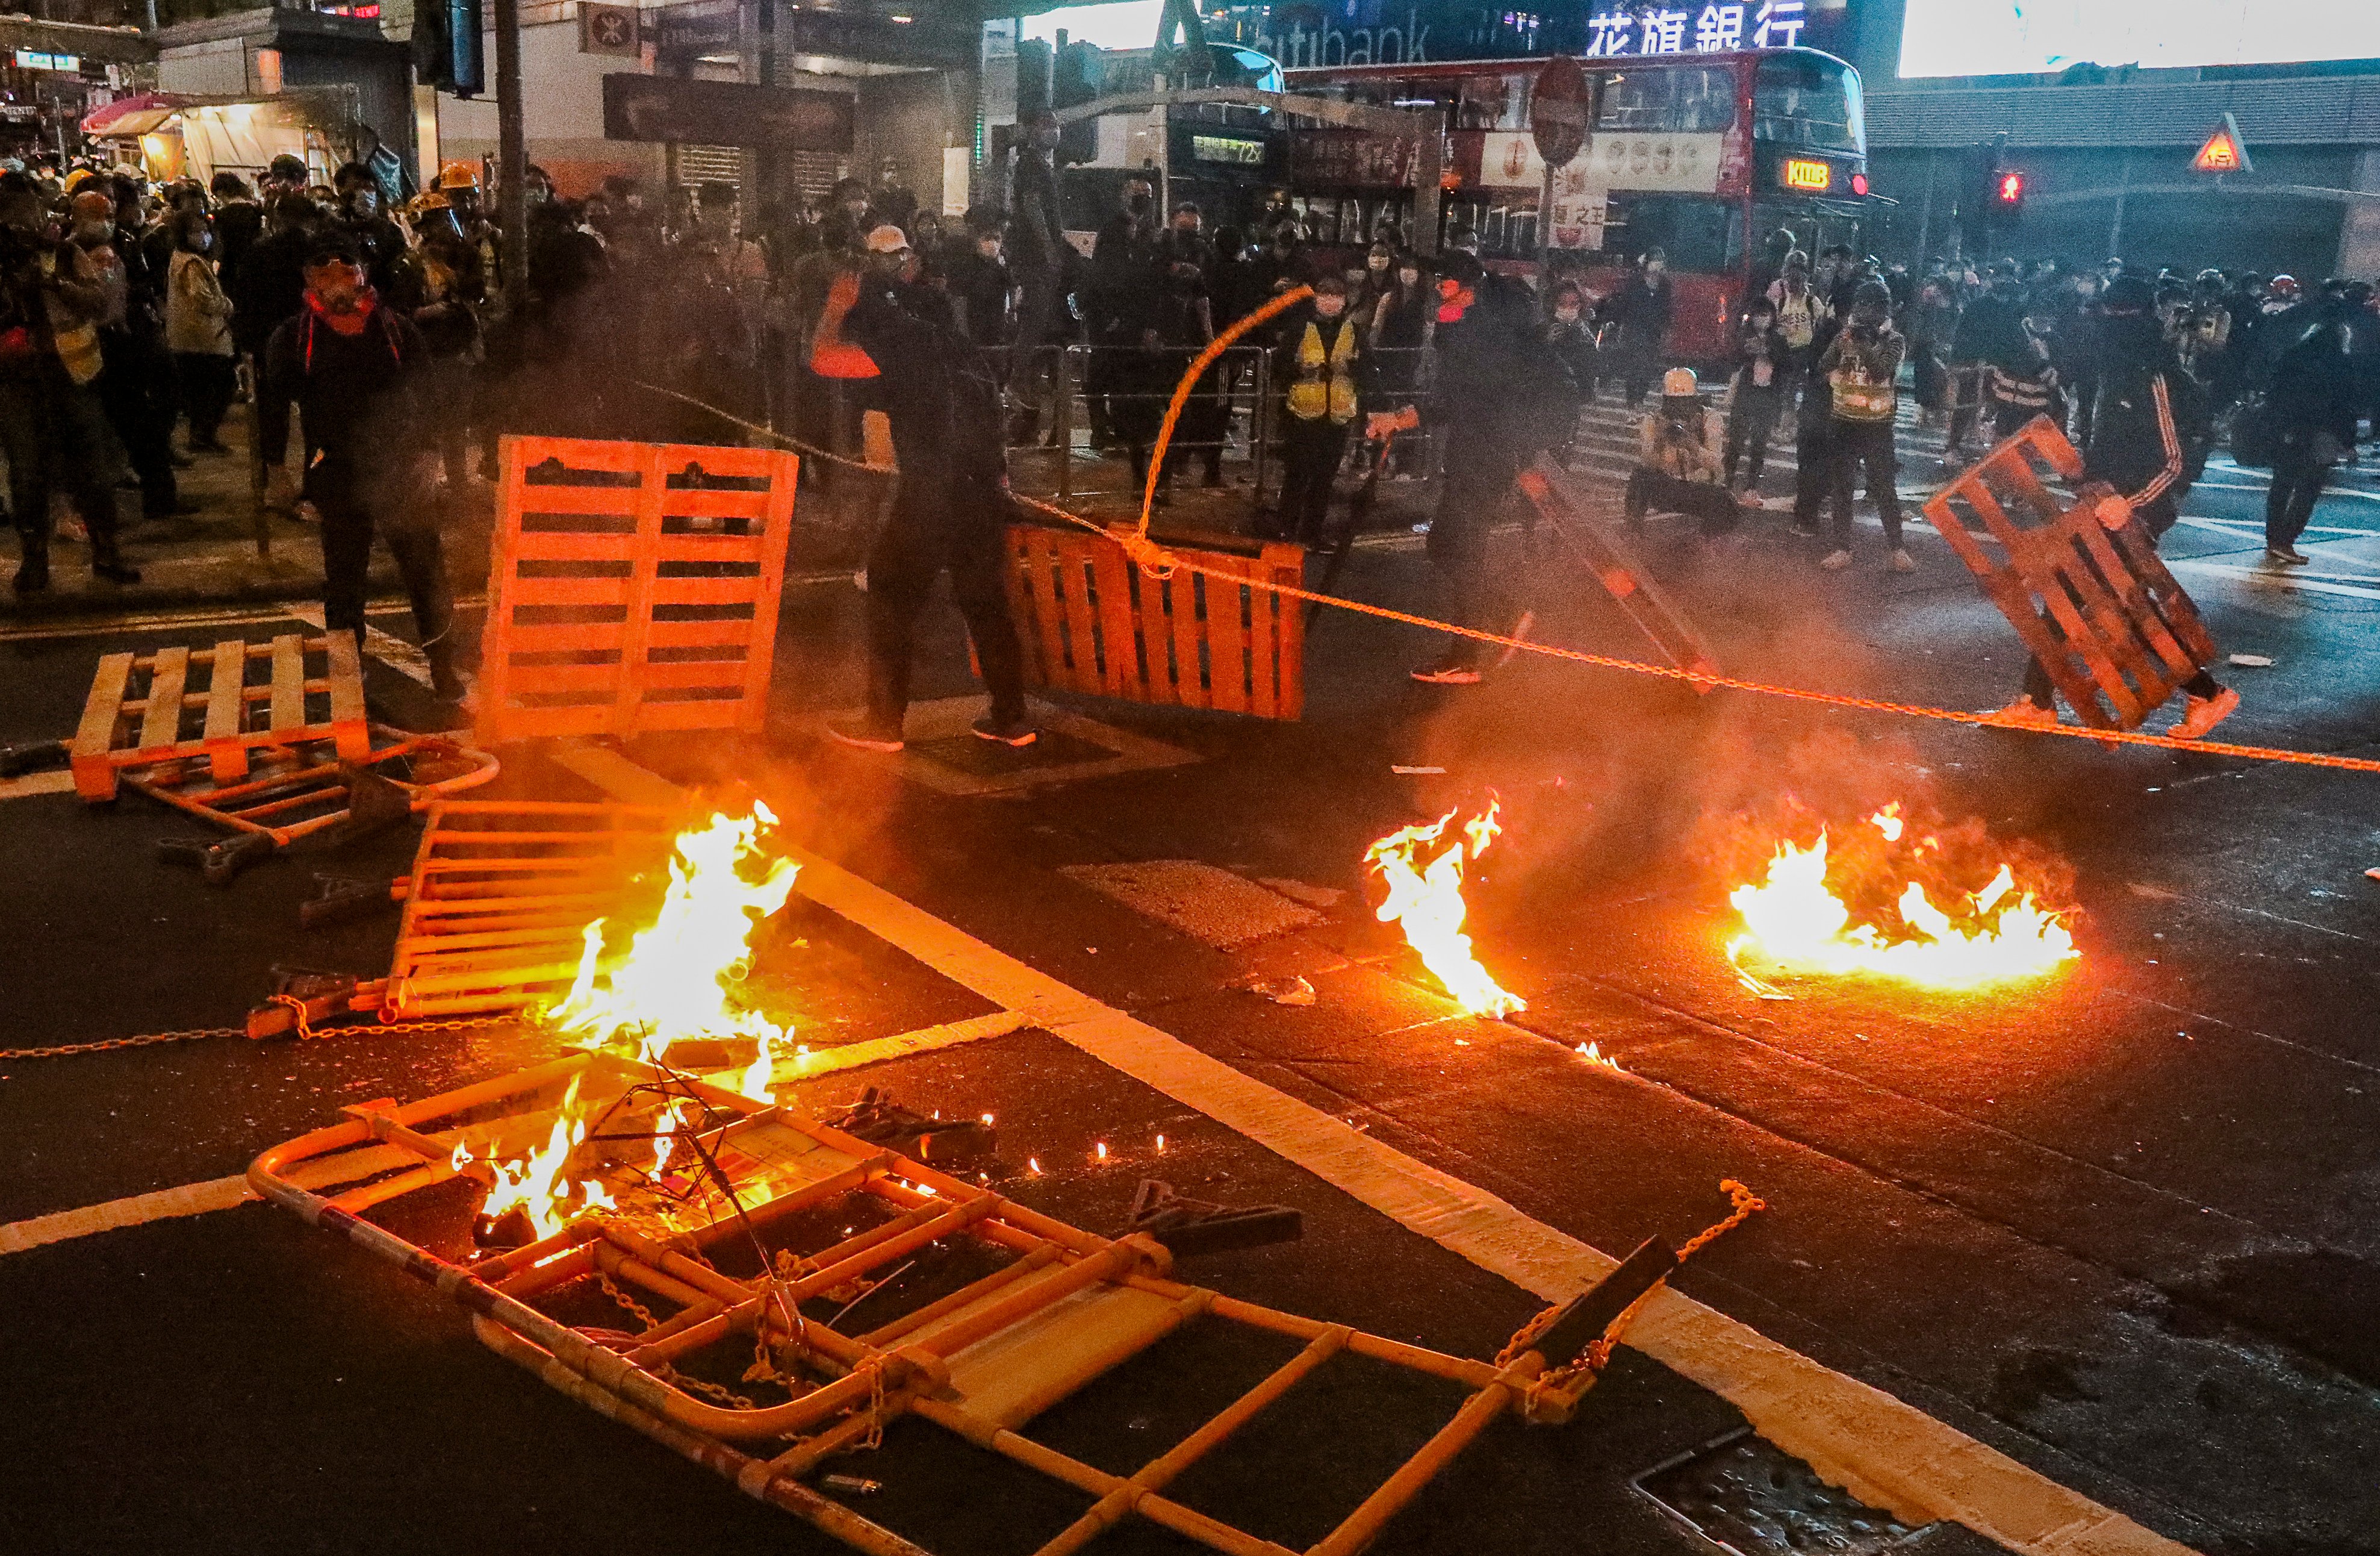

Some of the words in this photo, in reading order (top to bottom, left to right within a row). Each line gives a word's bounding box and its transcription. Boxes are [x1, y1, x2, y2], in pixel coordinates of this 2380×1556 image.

[1587, 2, 1805, 56] 花旗銀行
[1788, 160, 1828, 188] KMB
